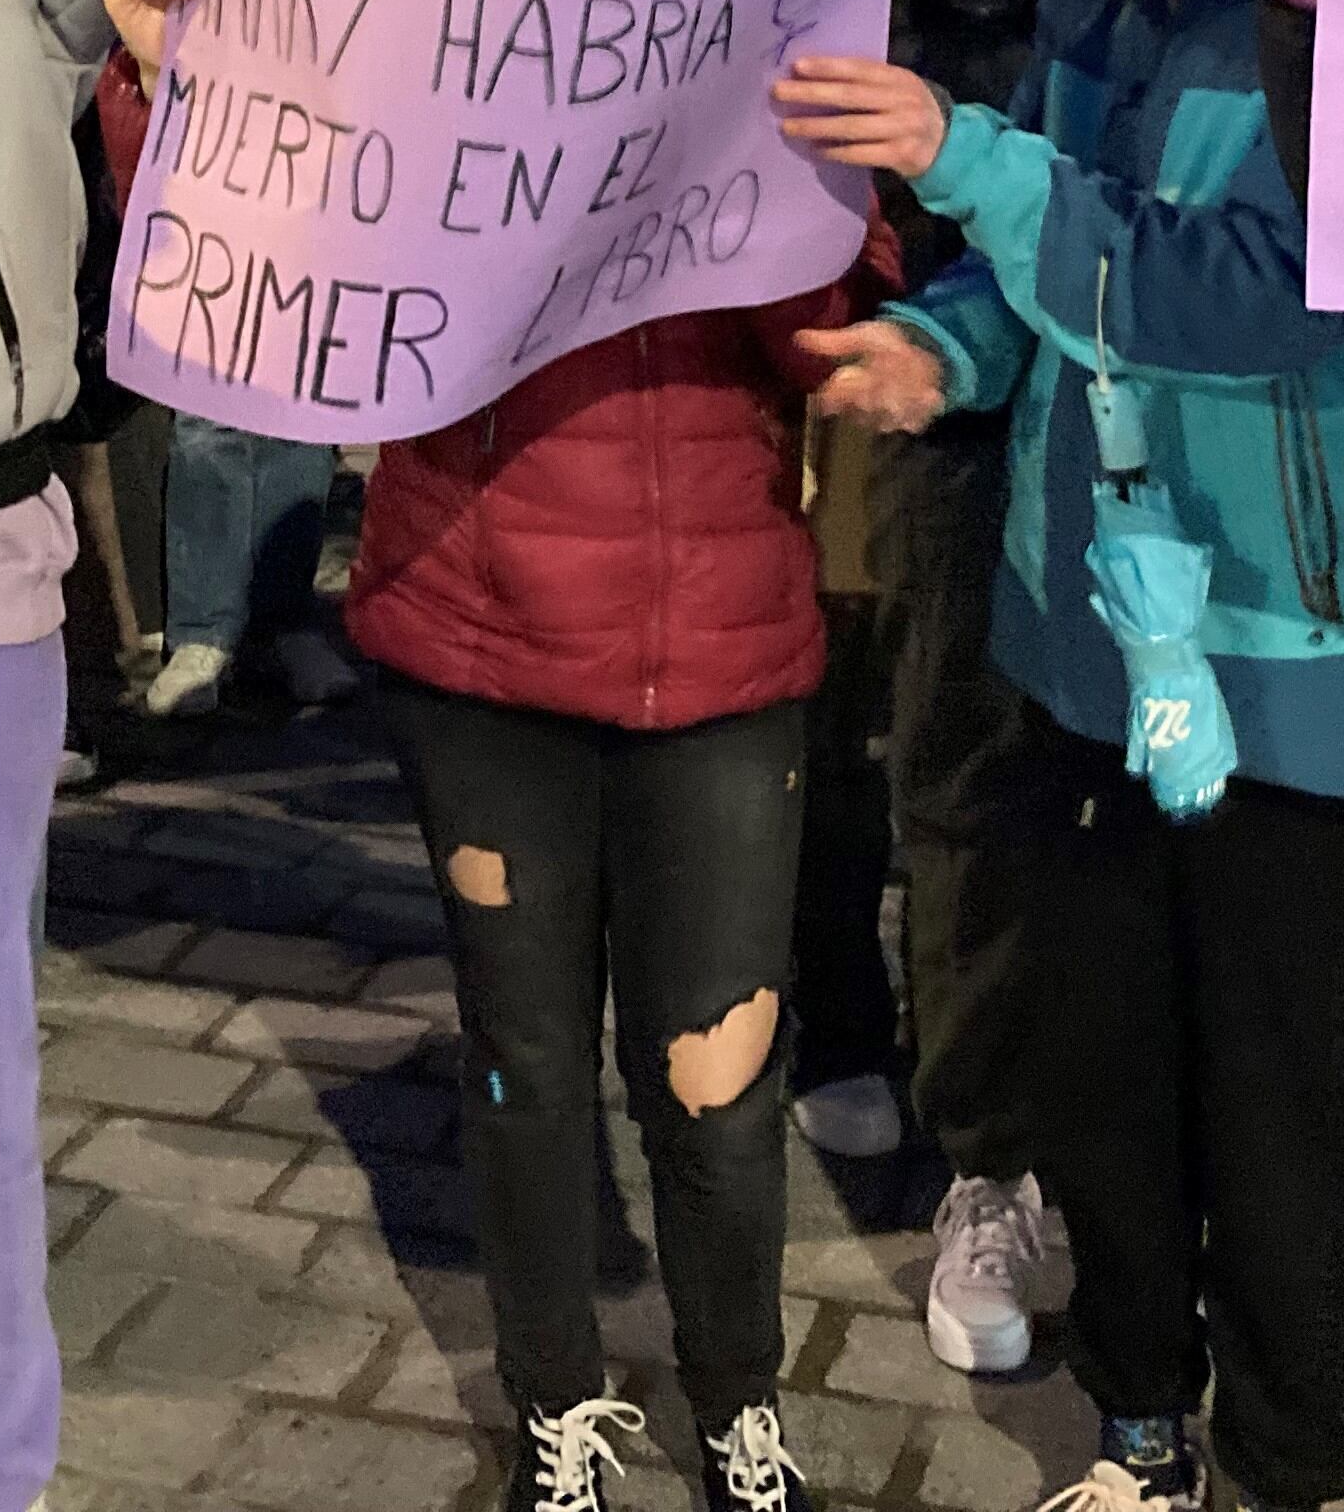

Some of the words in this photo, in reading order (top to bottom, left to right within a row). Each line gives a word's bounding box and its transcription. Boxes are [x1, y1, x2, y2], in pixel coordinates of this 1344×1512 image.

[151, 68, 394, 225] MUERTO
[441, 138, 563, 234] EN
[587, 120, 667, 213] EL
[127, 209, 448, 411] PRIMER
[511, 169, 761, 366] LIBRO
